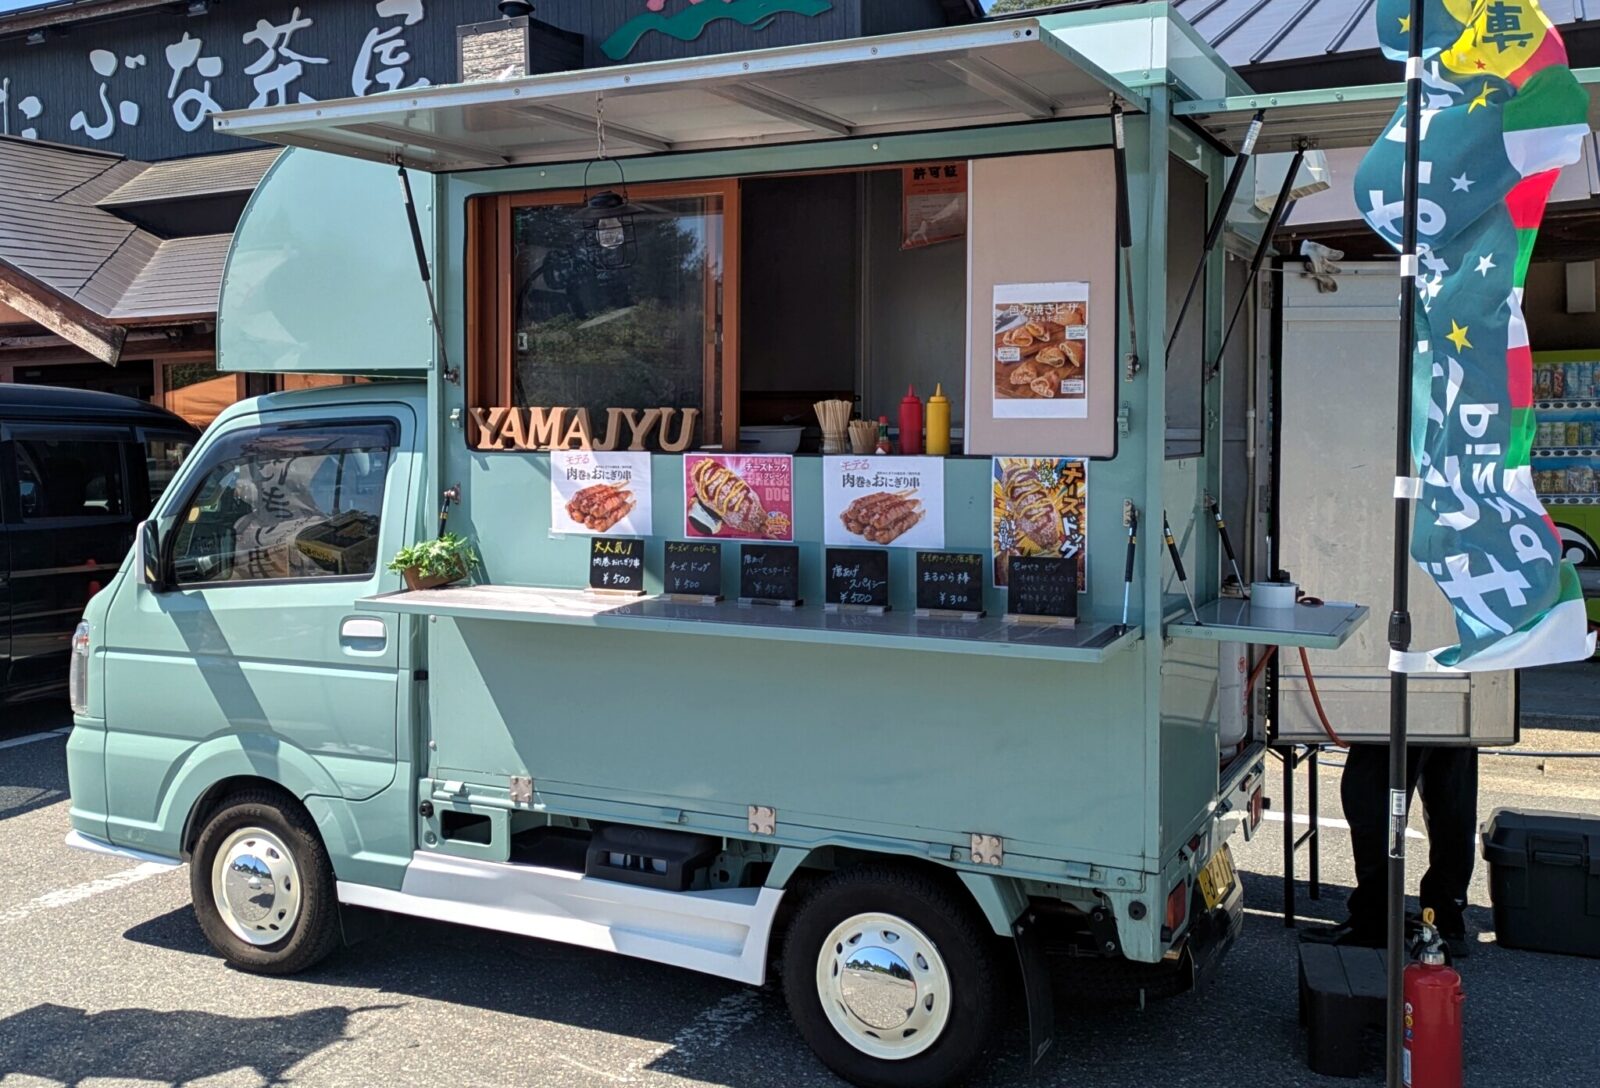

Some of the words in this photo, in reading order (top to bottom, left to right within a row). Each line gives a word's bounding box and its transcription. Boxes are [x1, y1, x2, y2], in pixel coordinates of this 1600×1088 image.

[912, 164, 958, 180] 許可証
[1008, 302, 1079, 317] 包み焼きピザ
[566, 454, 589, 465] モテる
[746, 462, 788, 472] チーズドッグ
[842, 459, 870, 471] モテる
[566, 467, 632, 481] 肉巻きおにぎり串
[842, 473, 920, 489] 肉巻きおにぎり串
[765, 487, 790, 502] DOG
[1061, 461, 1085, 559] チーズドッグ
